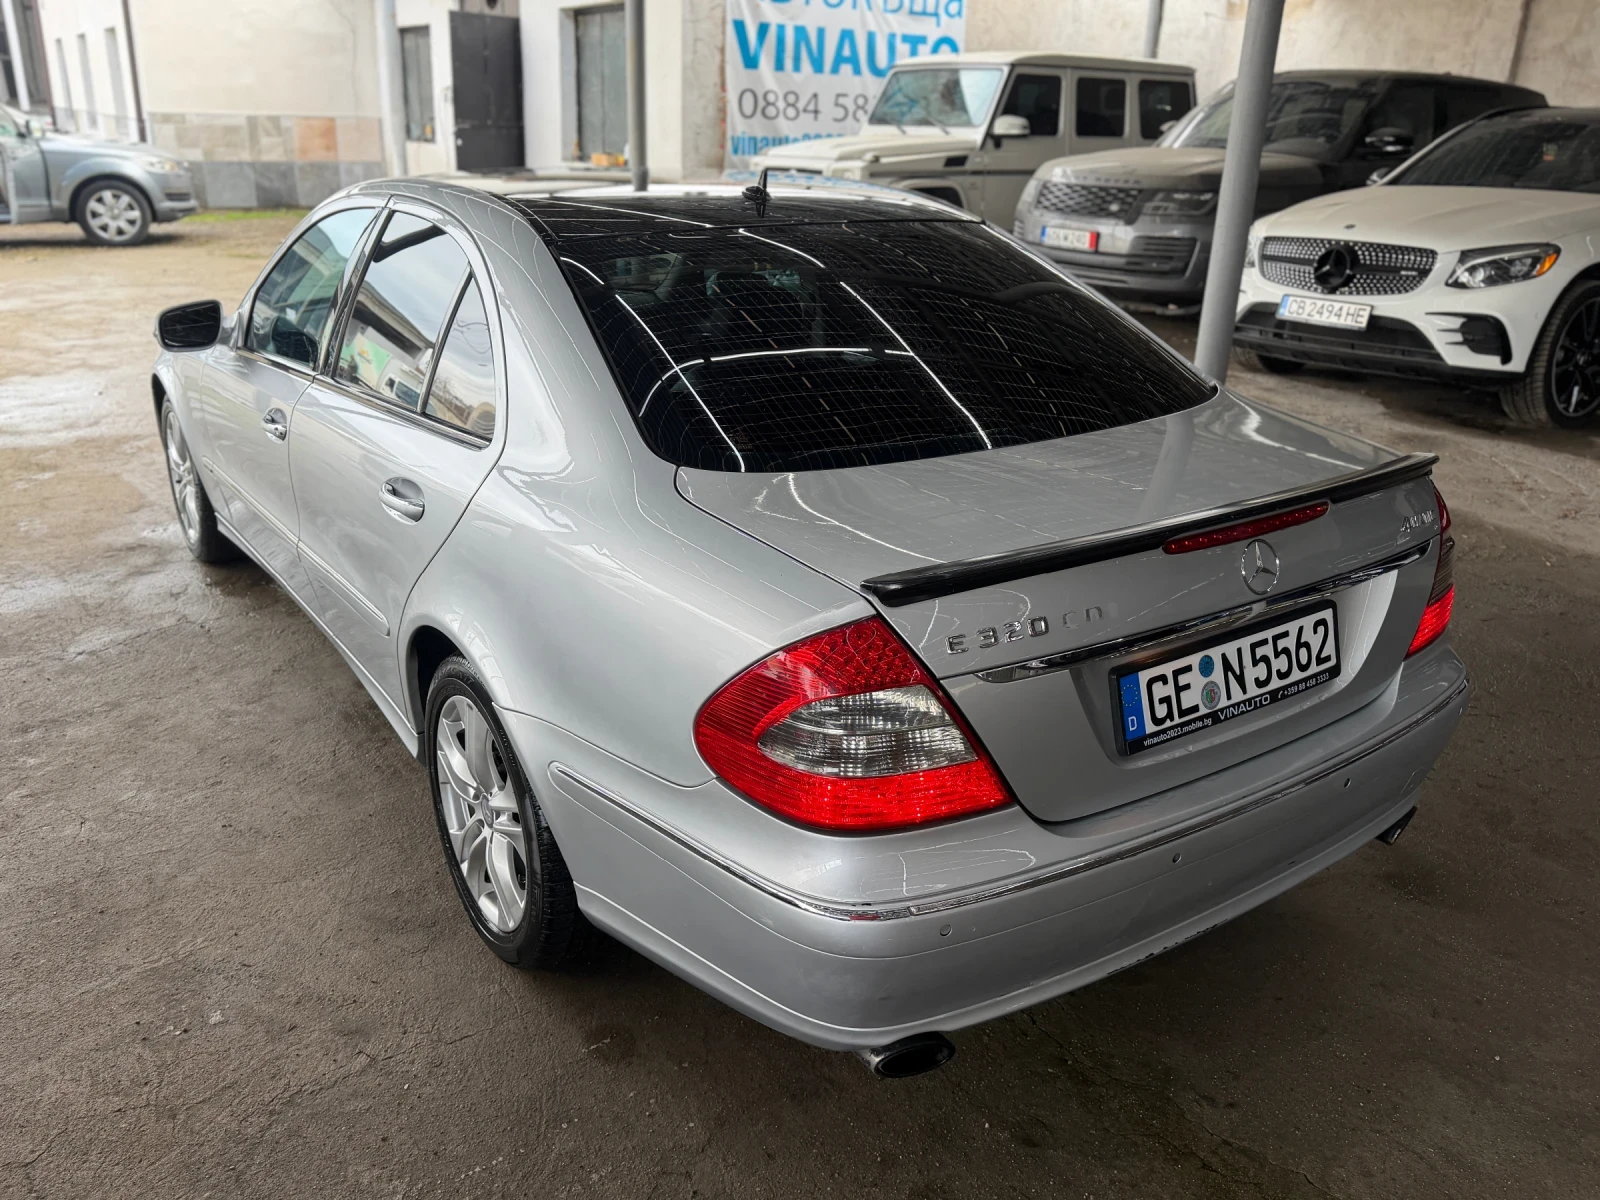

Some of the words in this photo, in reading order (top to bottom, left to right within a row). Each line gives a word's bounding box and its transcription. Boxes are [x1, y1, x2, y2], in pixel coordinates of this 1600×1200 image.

[738, 88, 821, 122] 0884
[1287, 299, 1305, 316] CB
[1307, 302, 1342, 320] 2494
[1344, 307, 1367, 325] HE
[945, 633, 969, 655] E
[976, 615, 1049, 649] 320
[1146, 664, 1200, 728] GE
[1127, 715, 1138, 732] D
[1143, 717, 1213, 747] vinauto2023.mobile.bg
[1218, 695, 1271, 721] VINAUTO
